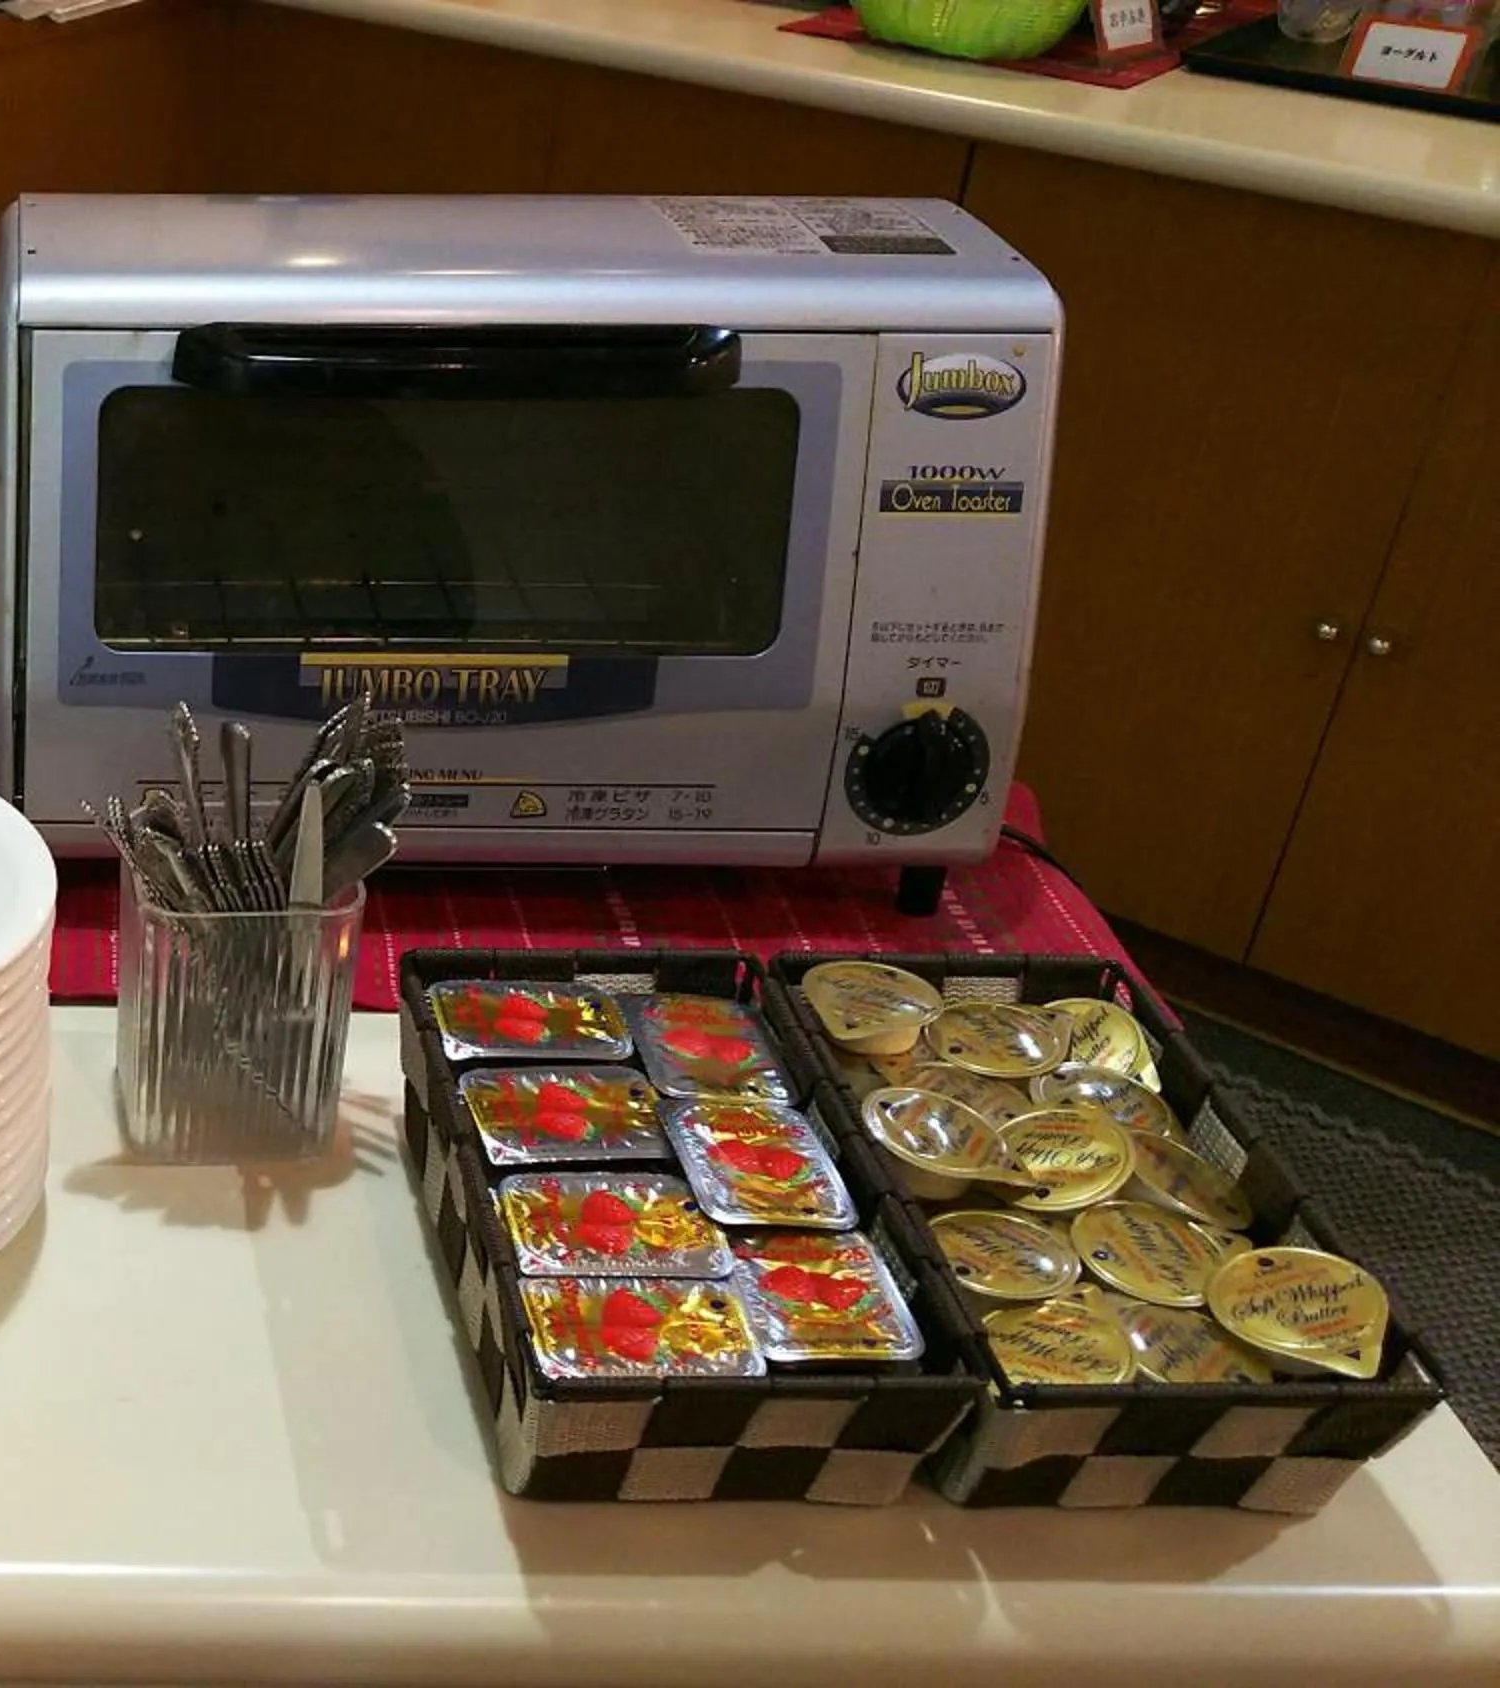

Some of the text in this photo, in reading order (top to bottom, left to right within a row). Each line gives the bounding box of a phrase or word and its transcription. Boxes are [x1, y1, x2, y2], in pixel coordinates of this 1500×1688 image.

[1380, 45, 1438, 62] ヨーグルト
[903, 351, 1017, 412] Jumbox
[908, 464, 1007, 480] 1000W
[891, 482, 1012, 511] Oven Toaster
[906, 655, 963, 669] タイマー
[320, 668, 548, 706] JUMBO TRAY
